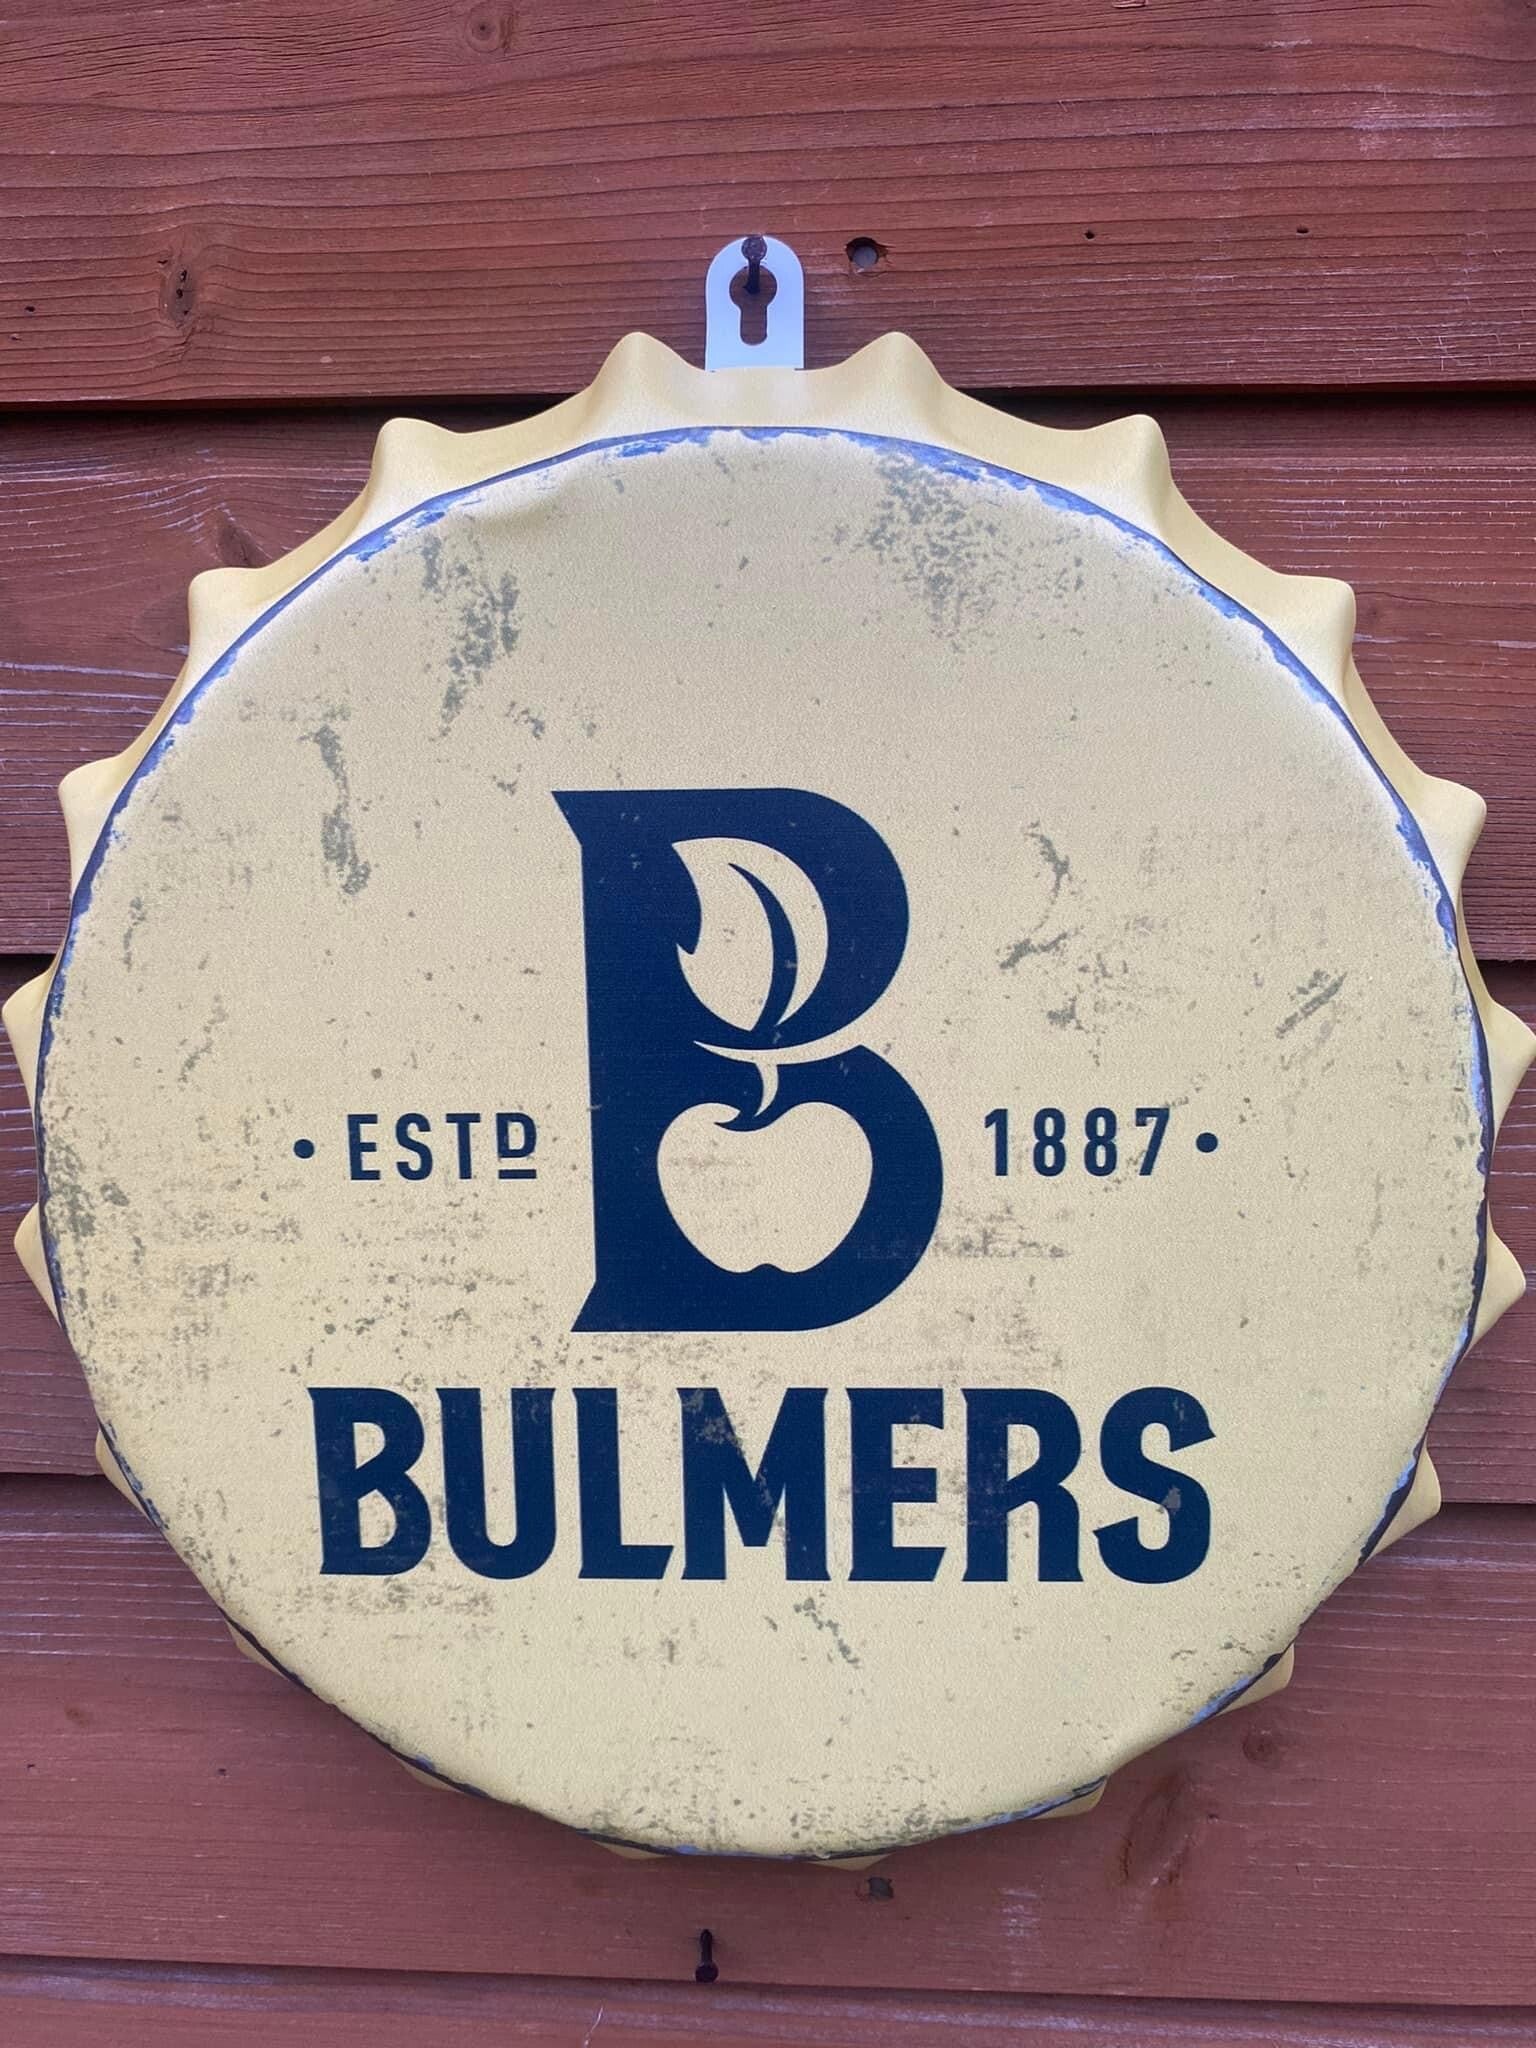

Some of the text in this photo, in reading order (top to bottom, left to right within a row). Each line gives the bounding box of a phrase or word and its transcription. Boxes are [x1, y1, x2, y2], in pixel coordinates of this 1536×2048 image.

[553, 788, 944, 1333] B
[347, 1112, 537, 1181] ESTD
[984, 1107, 1170, 1177] 1887
[307, 1386, 1216, 1584] BULMERS
